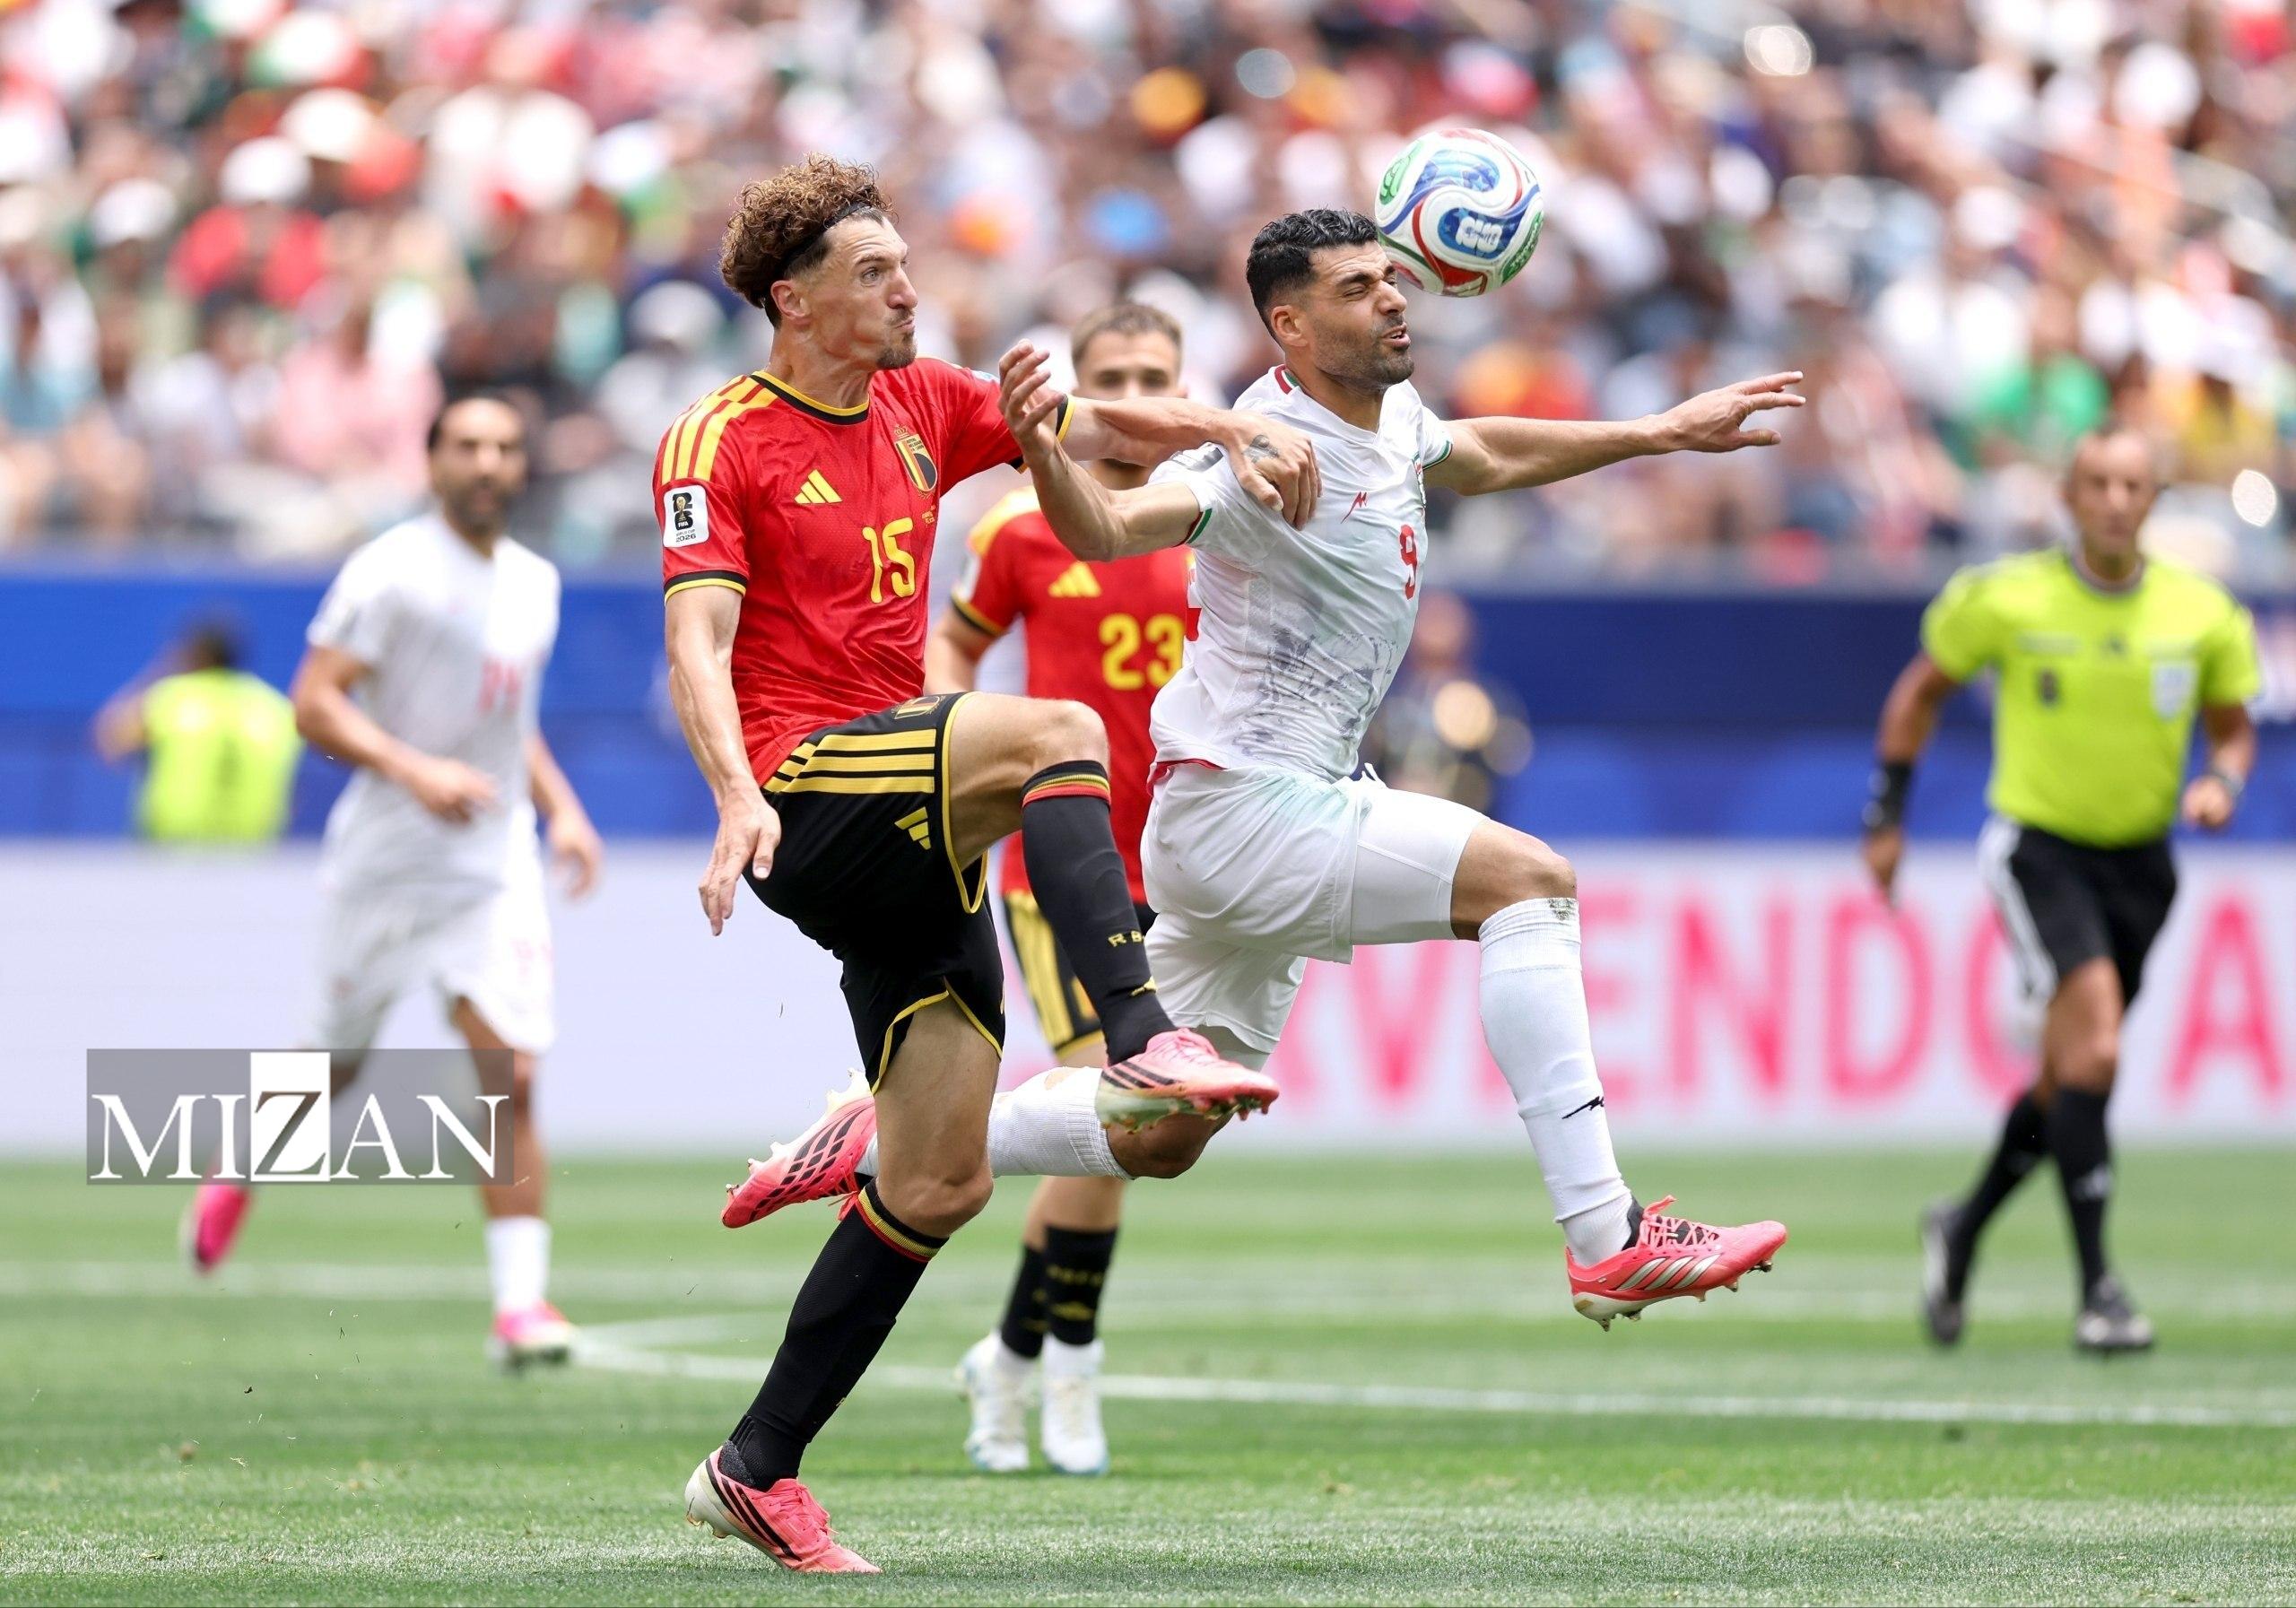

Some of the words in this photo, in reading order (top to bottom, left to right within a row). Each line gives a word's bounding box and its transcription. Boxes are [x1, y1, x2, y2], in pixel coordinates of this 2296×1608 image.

[675, 534, 697, 543] 2026
[862, 517, 916, 604] 15
[1399, 524, 1418, 600] 9
[1098, 613, 1185, 690] 23
